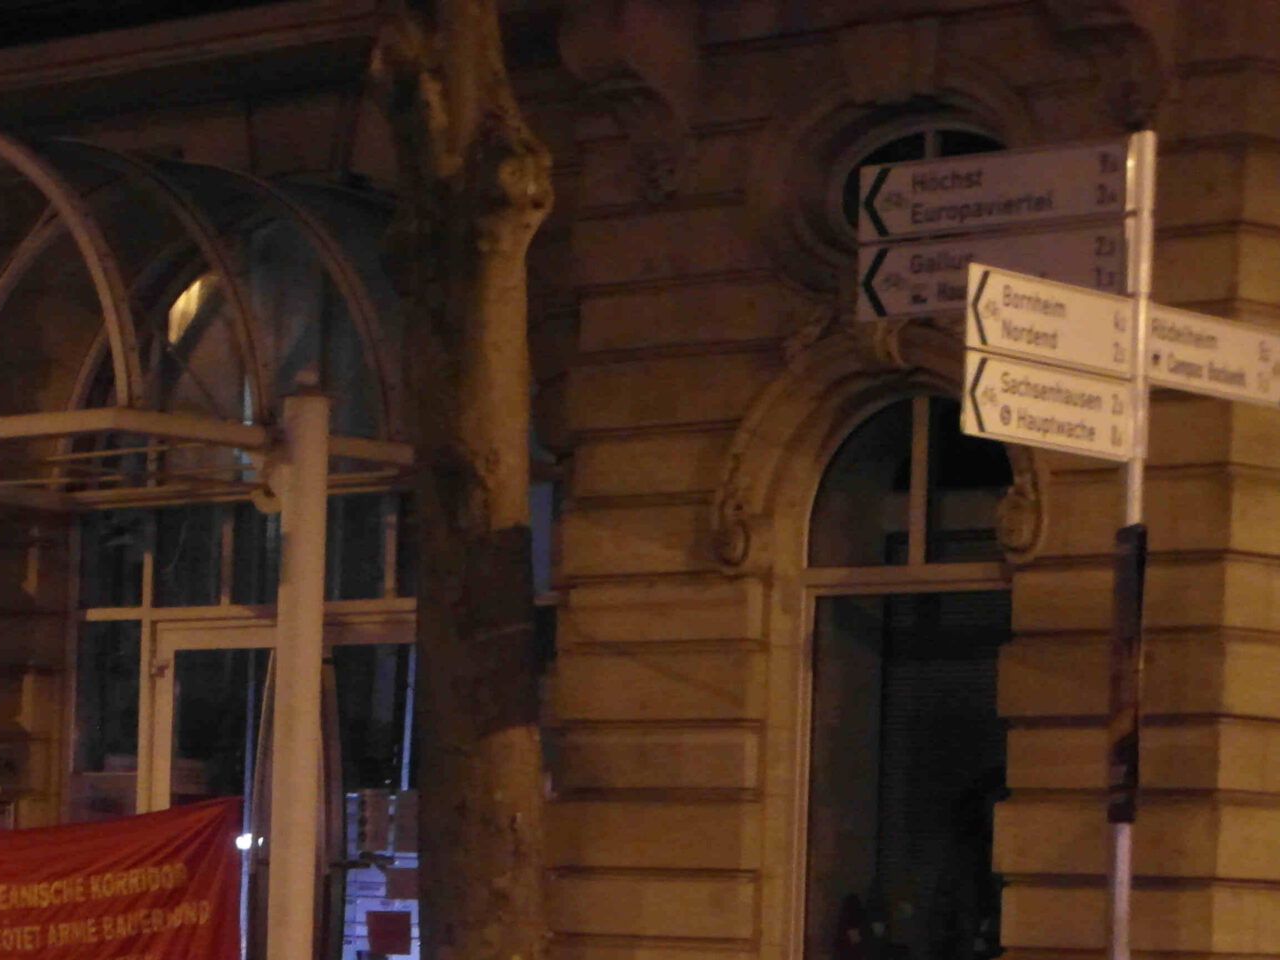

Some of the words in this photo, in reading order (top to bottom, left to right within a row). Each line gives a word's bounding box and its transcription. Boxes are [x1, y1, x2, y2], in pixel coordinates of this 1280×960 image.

[910, 191, 1055, 226] Europaviertel
[1002, 284, 1067, 318] Bornheim
[1001, 319, 1058, 351] Nordend
[1001, 371, 1103, 411] Sachsenhausen
[1016, 406, 1097, 443] Hauptwache
[90, 862, 188, 900] KORRIDOR
[47, 917, 99, 945] ARME
